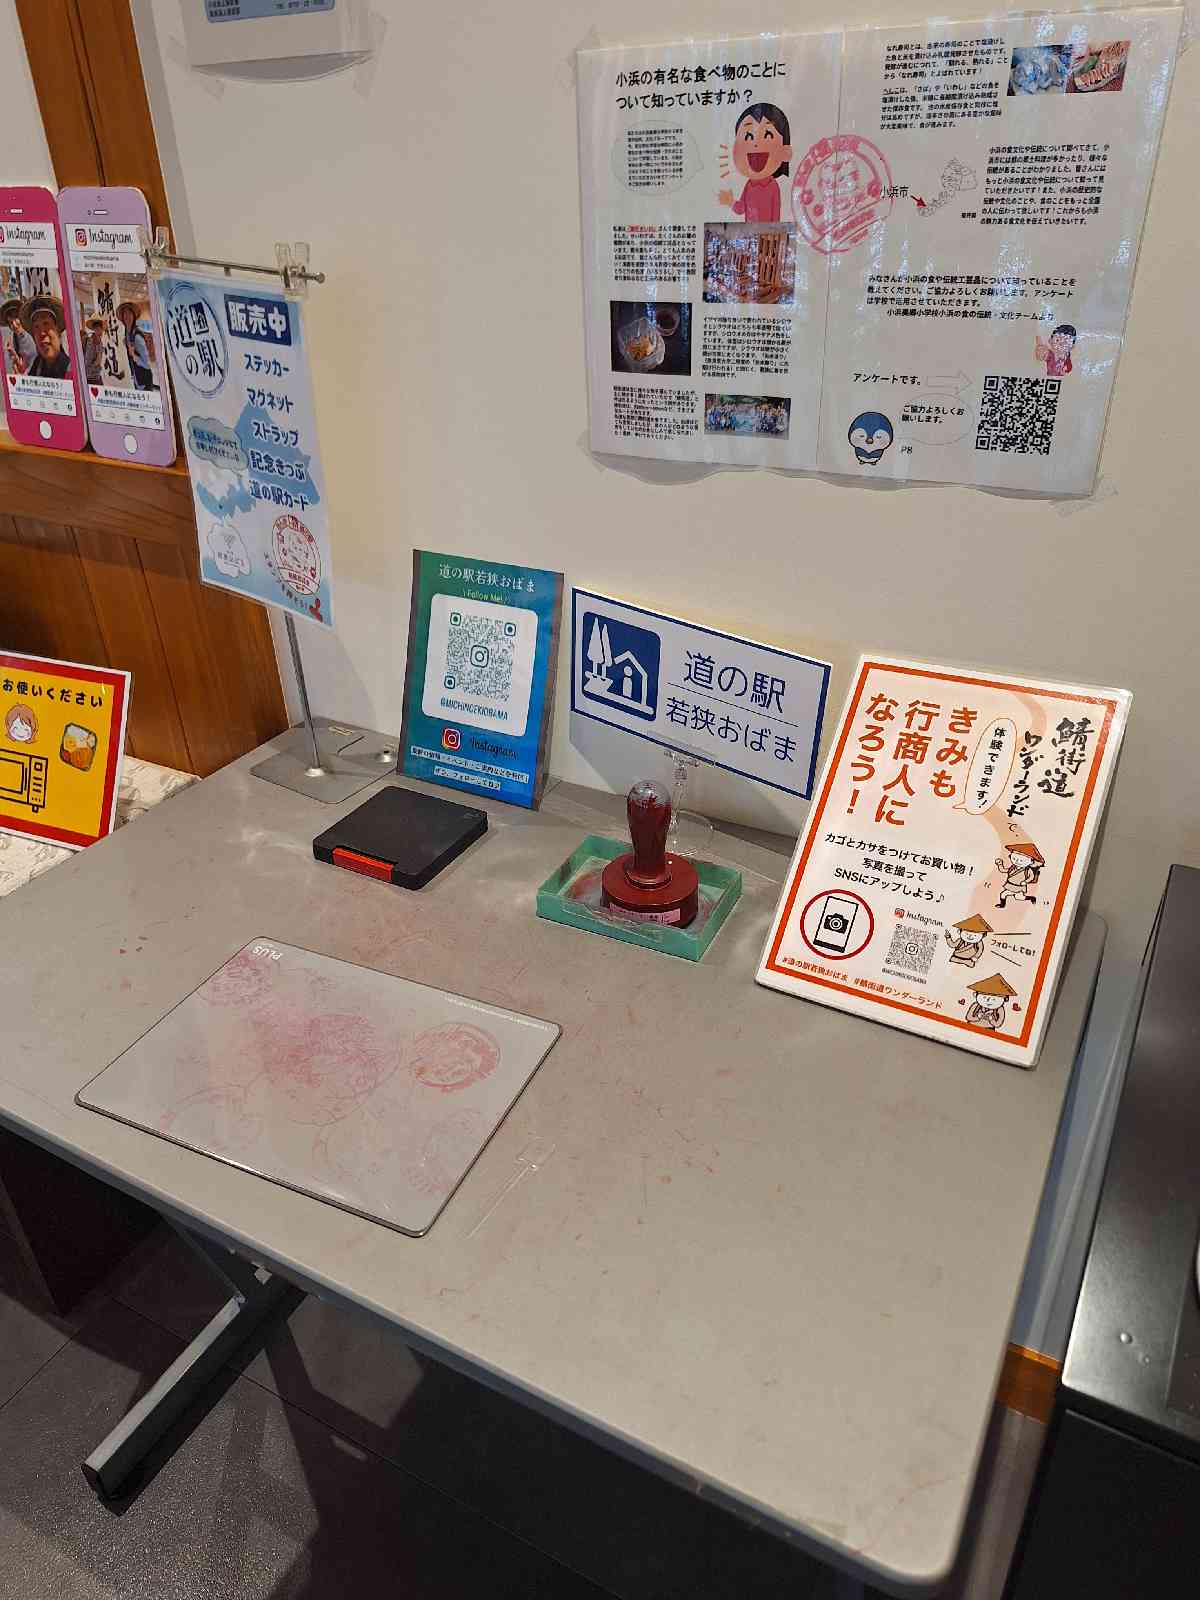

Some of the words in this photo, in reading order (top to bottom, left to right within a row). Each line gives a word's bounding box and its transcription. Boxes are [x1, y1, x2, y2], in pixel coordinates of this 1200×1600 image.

[616, 61, 786, 88] 小浜の有名な食べ物のことに
[616, 89, 753, 109] ついて知っていますか？
[880, 185, 909, 199] 小浜市
[88, 227, 134, 250] Instagram
[227, 300, 286, 339] 販売中
[244, 353, 290, 377] ステッカー
[853, 372, 921, 386] アンケートです。
[247, 387, 294, 413] マグネット
[903, 404, 964, 417] ご協力よろしくお
[253, 421, 299, 447] ストラップ
[902, 414, 944, 425] 願いします。
[250, 450, 306, 481] 記念きっぷ
[249, 479, 311, 512] 道の駅カード
[439, 562, 536, 593] 道の駅若狭おばま
[2, 678, 104, 708] お使いください
[683, 650, 786, 714] 道の駅
[665, 696, 798, 763] 若狭おばま
[846, 692, 900, 815] なろう！
[874, 699, 941, 826] 行商人に
[928, 706, 979, 799] きみも
[1036, 716, 1096, 798] 鯖街道
[1006, 731, 1044, 818] ワンダーランド
[824, 831, 976, 877] カゴとカサをつけてお買い物！
[862, 857, 928, 883] 写真を撮って
[252, 945, 284, 961] PLUS
